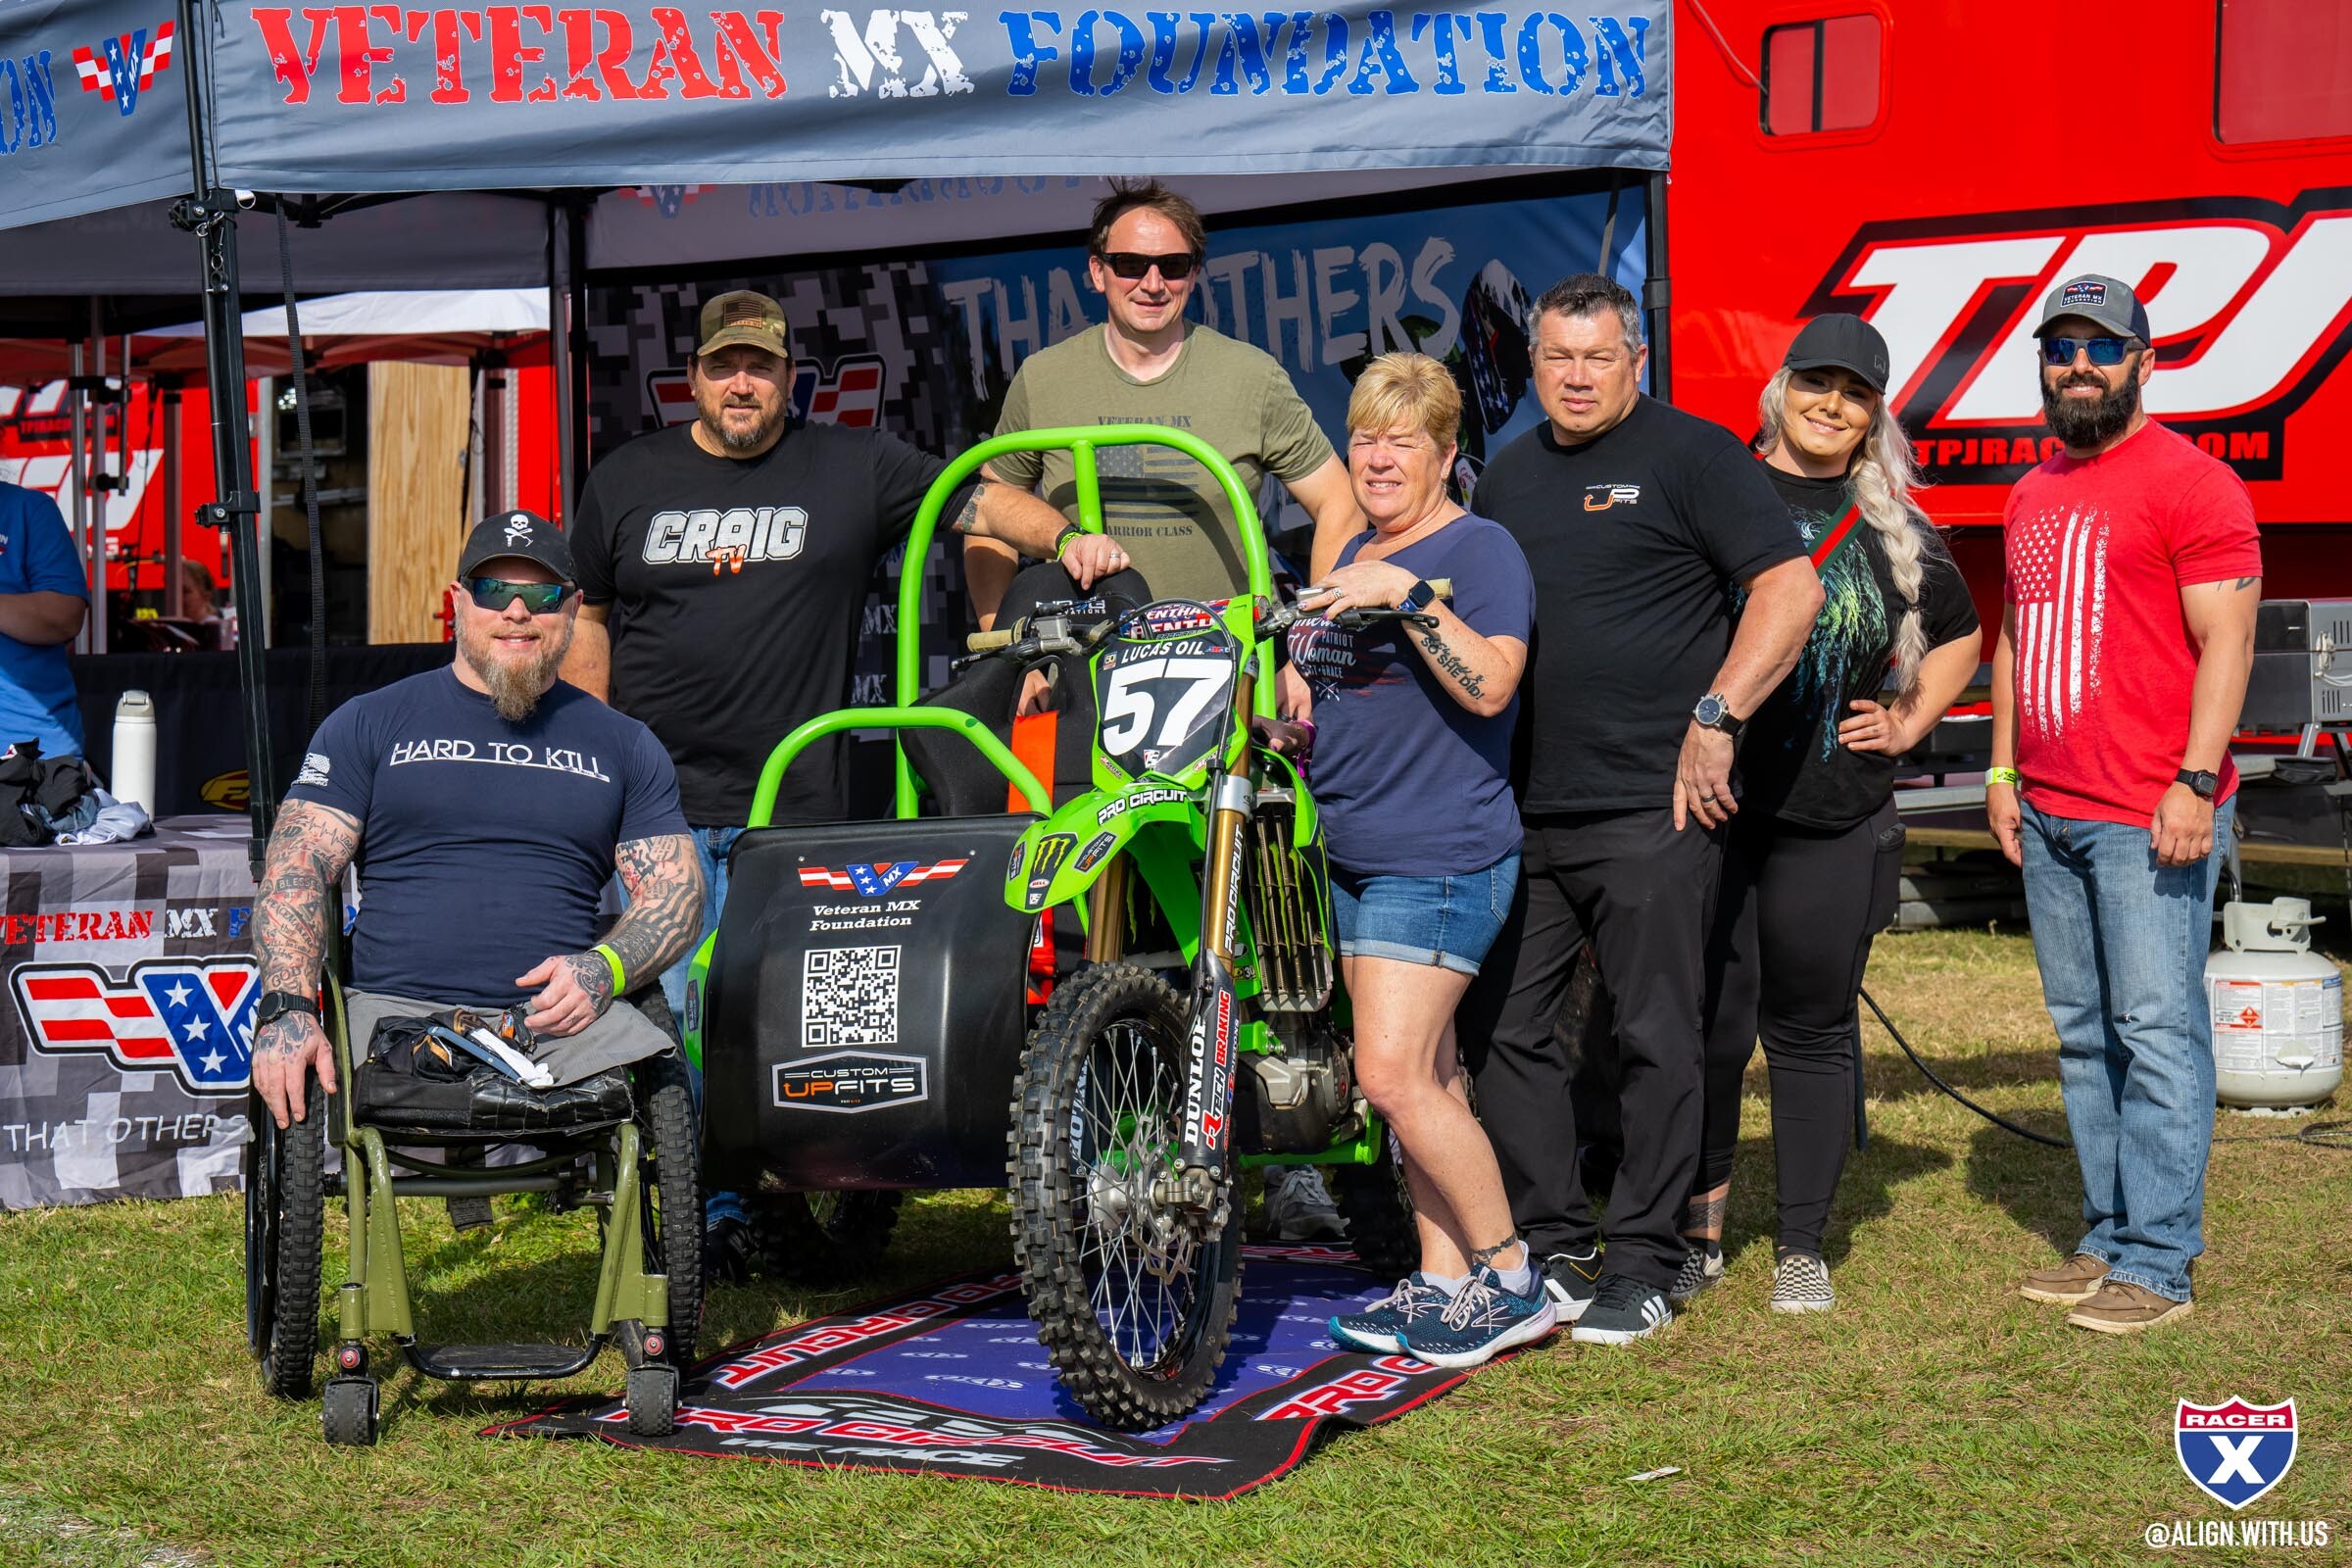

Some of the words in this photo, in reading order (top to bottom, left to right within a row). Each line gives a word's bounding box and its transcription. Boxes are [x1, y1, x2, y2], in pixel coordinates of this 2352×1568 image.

[252, 5, 785, 105] VETERAN
[821, 9, 976, 100] MX
[1000, 11, 1650, 98] FOUNDATION
[2064, 293, 2091, 302] VETERAN
[945, 265, 1093, 401] THA
[1171, 416, 1192, 427] MX
[642, 506, 808, 565] CRAIG
[1106, 525, 1154, 537] ARRIOR
[1156, 525, 1193, 537] CLASS
[705, 544, 747, 576] TV
[863, 604, 899, 635] MX
[1121, 641, 1173, 664] LUCAS
[1287, 630, 1357, 666] Woman
[1321, 630, 1354, 648] PATRIOT
[1421, 636, 1440, 655] SO
[1437, 655, 1460, 678] SHE
[851, 673, 887, 704] MX
[1102, 658, 1233, 757] 57
[390, 739, 476, 766] HARD
[488, 742, 533, 765] TO
[546, 747, 611, 783] KILL
[1097, 797, 1127, 826] PRO
[1128, 789, 1188, 809] CIRCUIT
[1080, 834, 1113, 871] UPFITS
[1228, 823, 1245, 908] CIRCUIT
[808, 916, 912, 932] Foundation
[812, 904, 882, 916] Veteran
[885, 900, 922, 912] MX
[0, 910, 154, 946] ETERAN
[164, 907, 219, 939] MX
[1225, 906, 1237, 954] PRO
[1215, 989, 1232, 1068] BRAKING
[783, 1077, 915, 1099] UPFITS
[810, 1067, 888, 1079] CUSTOM
[3, 1119, 96, 1152] THAT
[719, 1437, 833, 1451] WE
[825, 1446, 1026, 1468] RACE
